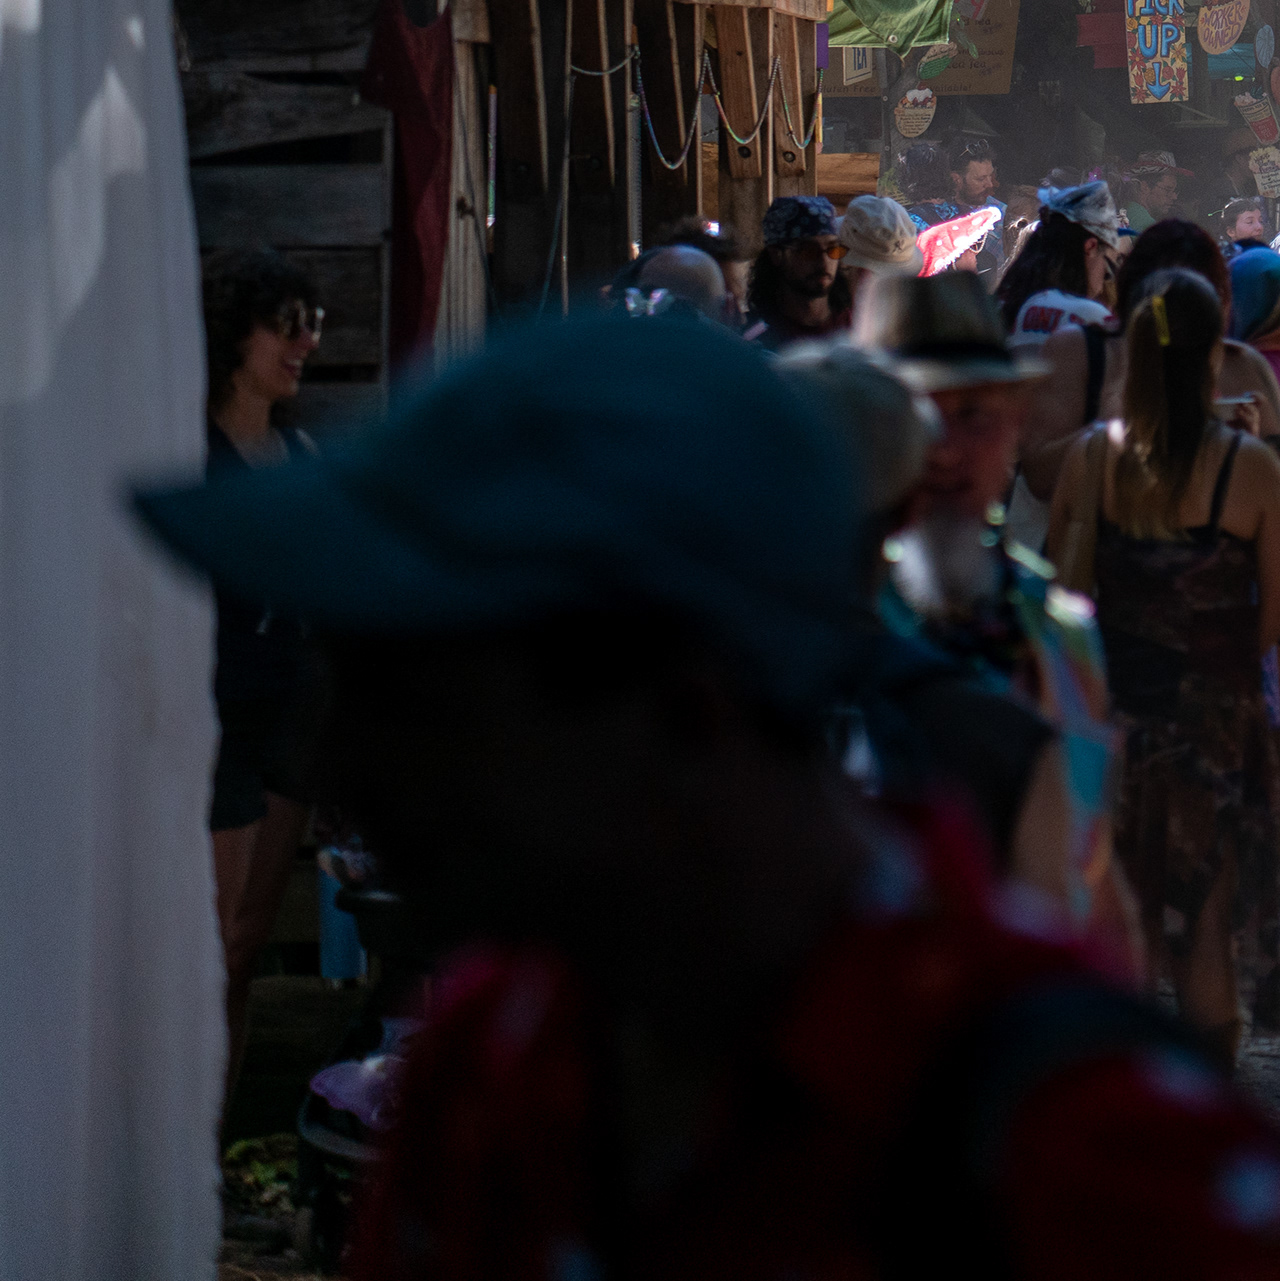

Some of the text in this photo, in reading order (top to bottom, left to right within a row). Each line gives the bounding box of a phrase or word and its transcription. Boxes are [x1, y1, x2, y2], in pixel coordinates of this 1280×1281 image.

[1203, 1, 1243, 30] WORKER
[1137, 22, 1180, 59] UP
[1203, 21, 1242, 50] OWNED
